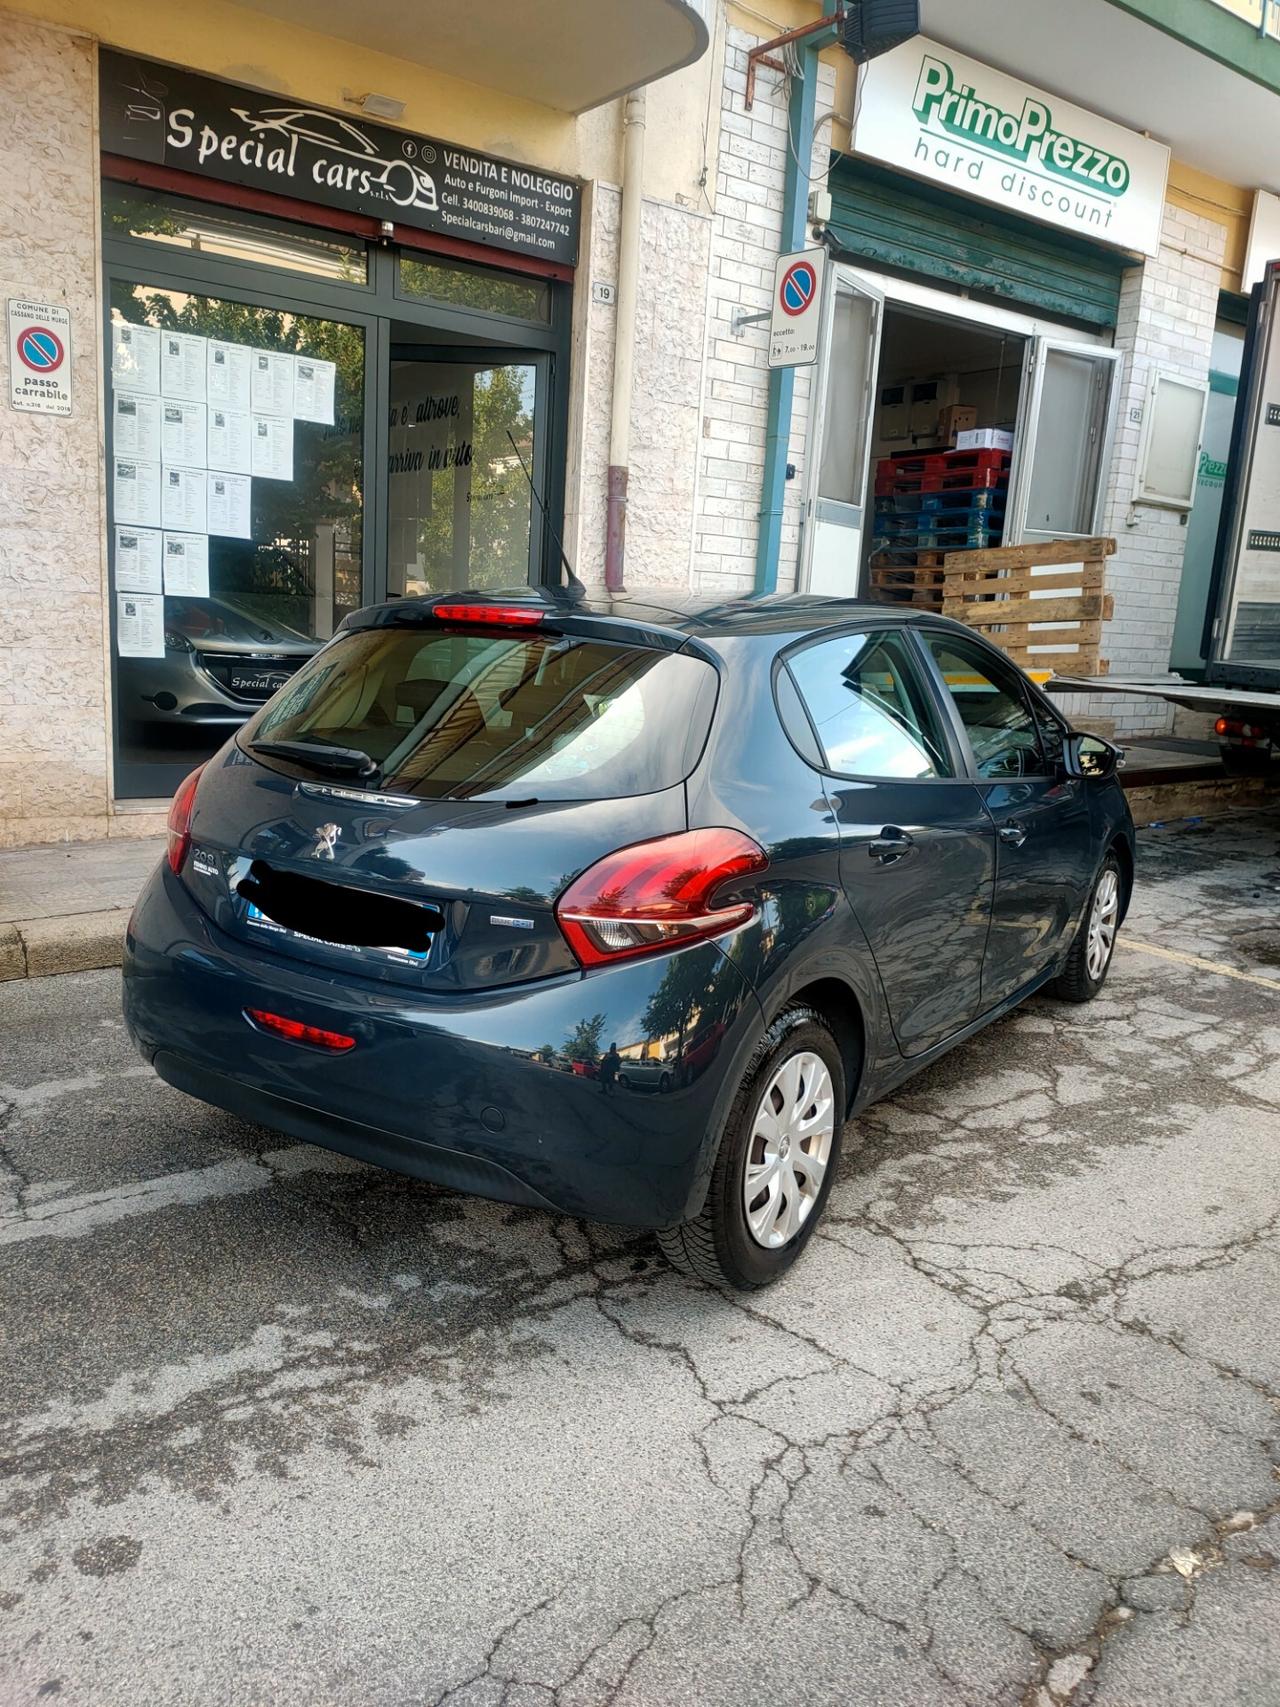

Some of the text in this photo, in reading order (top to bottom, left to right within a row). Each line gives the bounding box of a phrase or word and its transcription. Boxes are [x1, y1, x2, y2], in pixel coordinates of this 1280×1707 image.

[912, 54, 1130, 197] PrimoPrezzo
[166, 108, 371, 194] Special cars
[443, 150, 574, 201] VENDITA E NOLEGGIO
[444, 173, 467, 189] Auto
[468, 182, 474, 191] e
[475, 182, 508, 200] Furgoni
[510, 191, 539, 209] Import
[545, 201, 573, 218] Export
[914, 137, 1113, 228] hard discount
[441, 192, 460, 207] Cell.
[462, 198, 514, 221] 3400839068
[521, 213, 570, 237] 3807247742
[441, 210, 556, 249] Specialcarsbari@gmail.com
[16, 303, 49, 313] COMUNE
[599, 287, 610, 299] 19
[15, 387, 68, 400] carrabile
[24, 377, 59, 388] passo
[232, 677, 269, 688] Special
